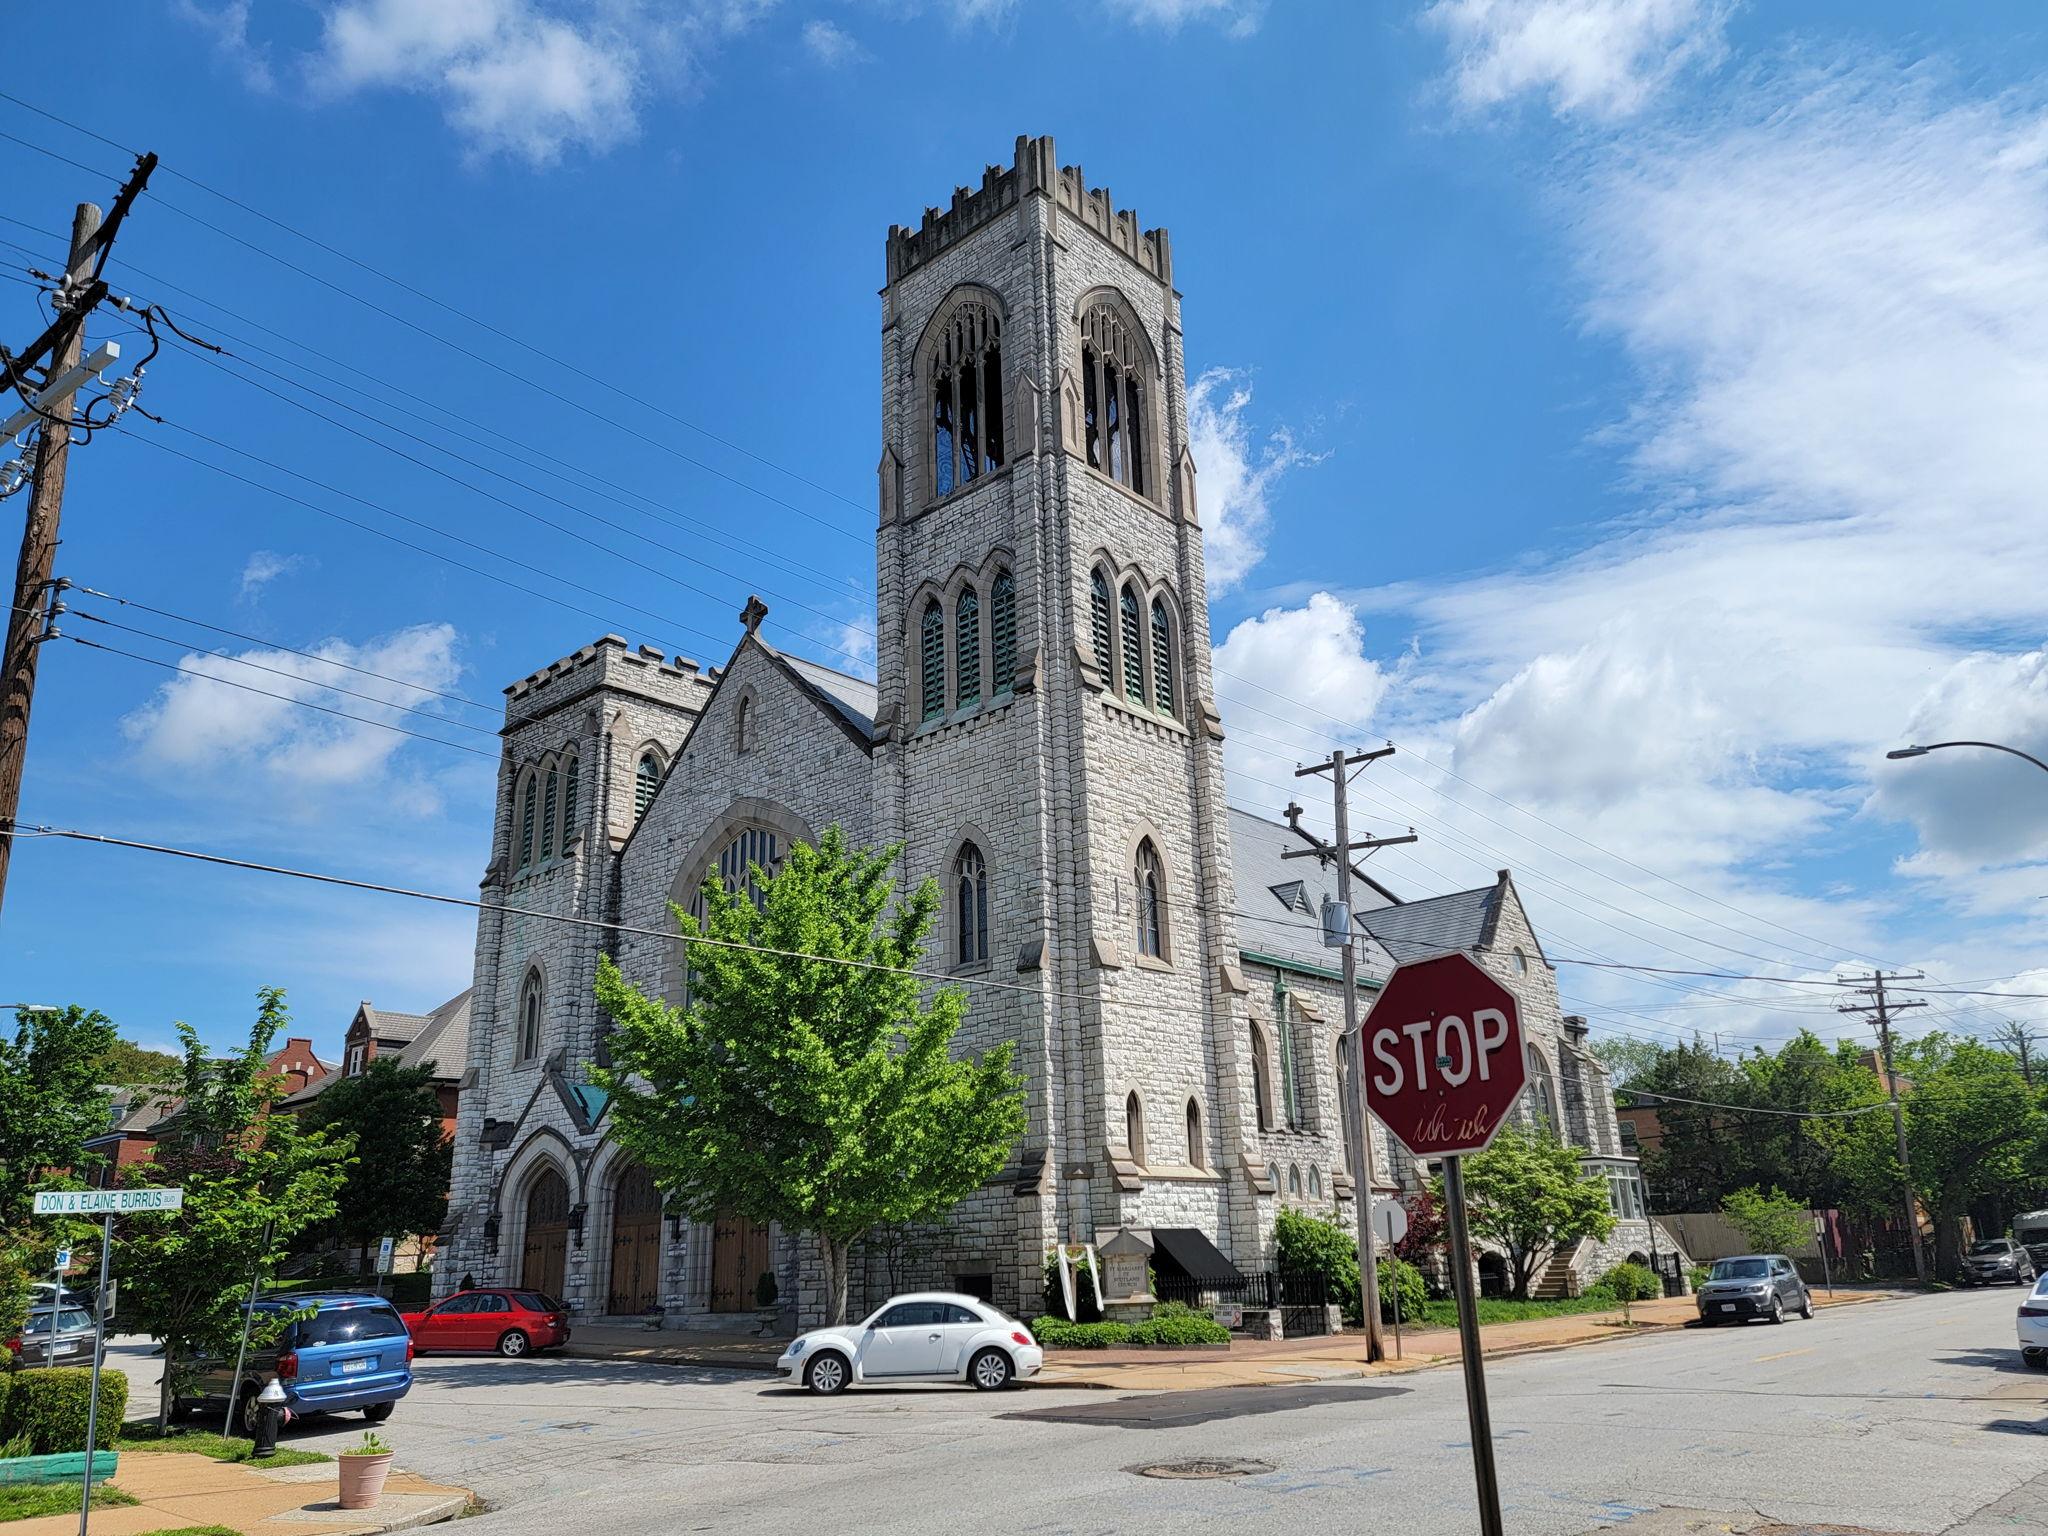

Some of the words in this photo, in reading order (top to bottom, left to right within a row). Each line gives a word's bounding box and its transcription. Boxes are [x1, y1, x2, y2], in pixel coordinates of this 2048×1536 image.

[1373, 1008, 1509, 1096] STOP
[41, 1195, 64, 1211] DON
[68, 1196, 76, 1210] &
[80, 1193, 117, 1210] ELAINE
[121, 1191, 162, 1208] BURRUS
